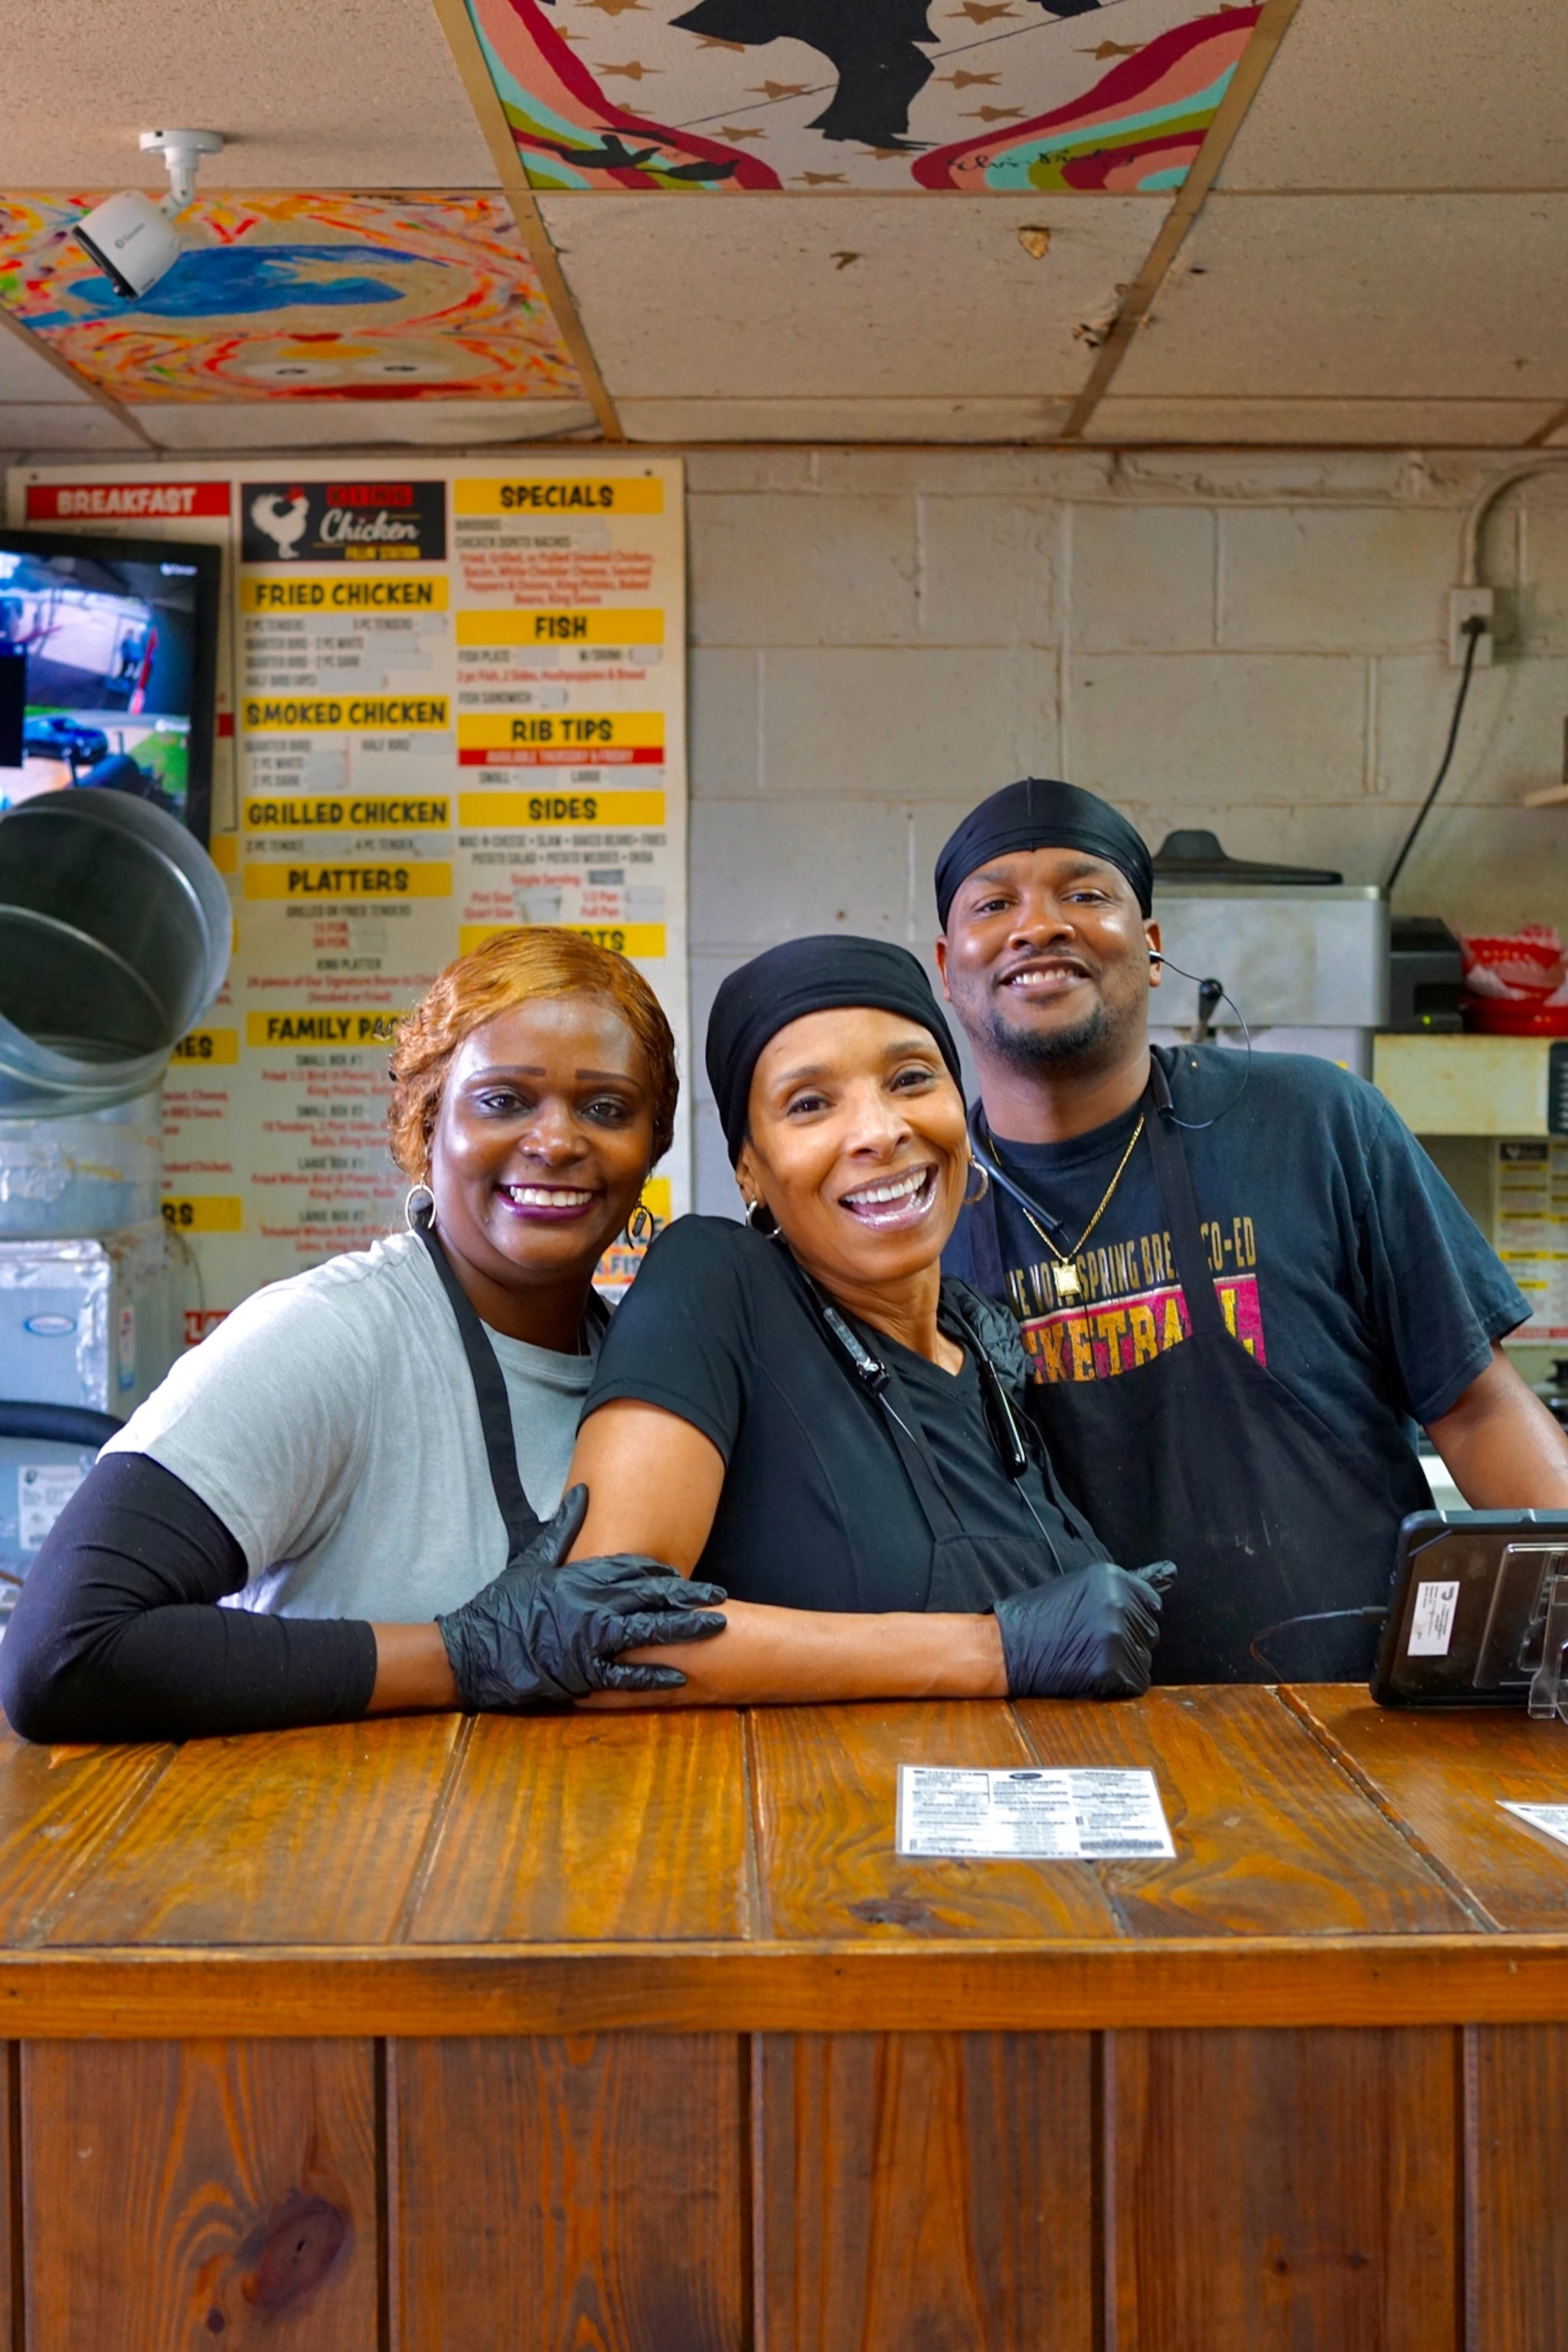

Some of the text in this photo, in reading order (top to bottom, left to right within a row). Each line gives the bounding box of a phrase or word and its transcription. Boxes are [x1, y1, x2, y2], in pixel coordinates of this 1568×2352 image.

[57, 488, 198, 515] BREAKFAST
[501, 485, 614, 508] SPECIALS
[319, 508, 420, 543] Chicken
[256, 583, 433, 606] FRIED CHICKEN
[534, 616, 588, 639] FISH
[247, 701, 446, 725] SMOKED CHICKEN
[512, 720, 613, 742] RIB TIPS
[248, 802, 446, 825] GRILLED CHICKEN
[529, 798, 597, 821] SIDES
[289, 869, 410, 892] PLATTERS
[268, 1018, 351, 1040] FAMILY
[1076, 1240, 1140, 1301] SPRING
[1141, 1231, 1180, 1285] BRE
